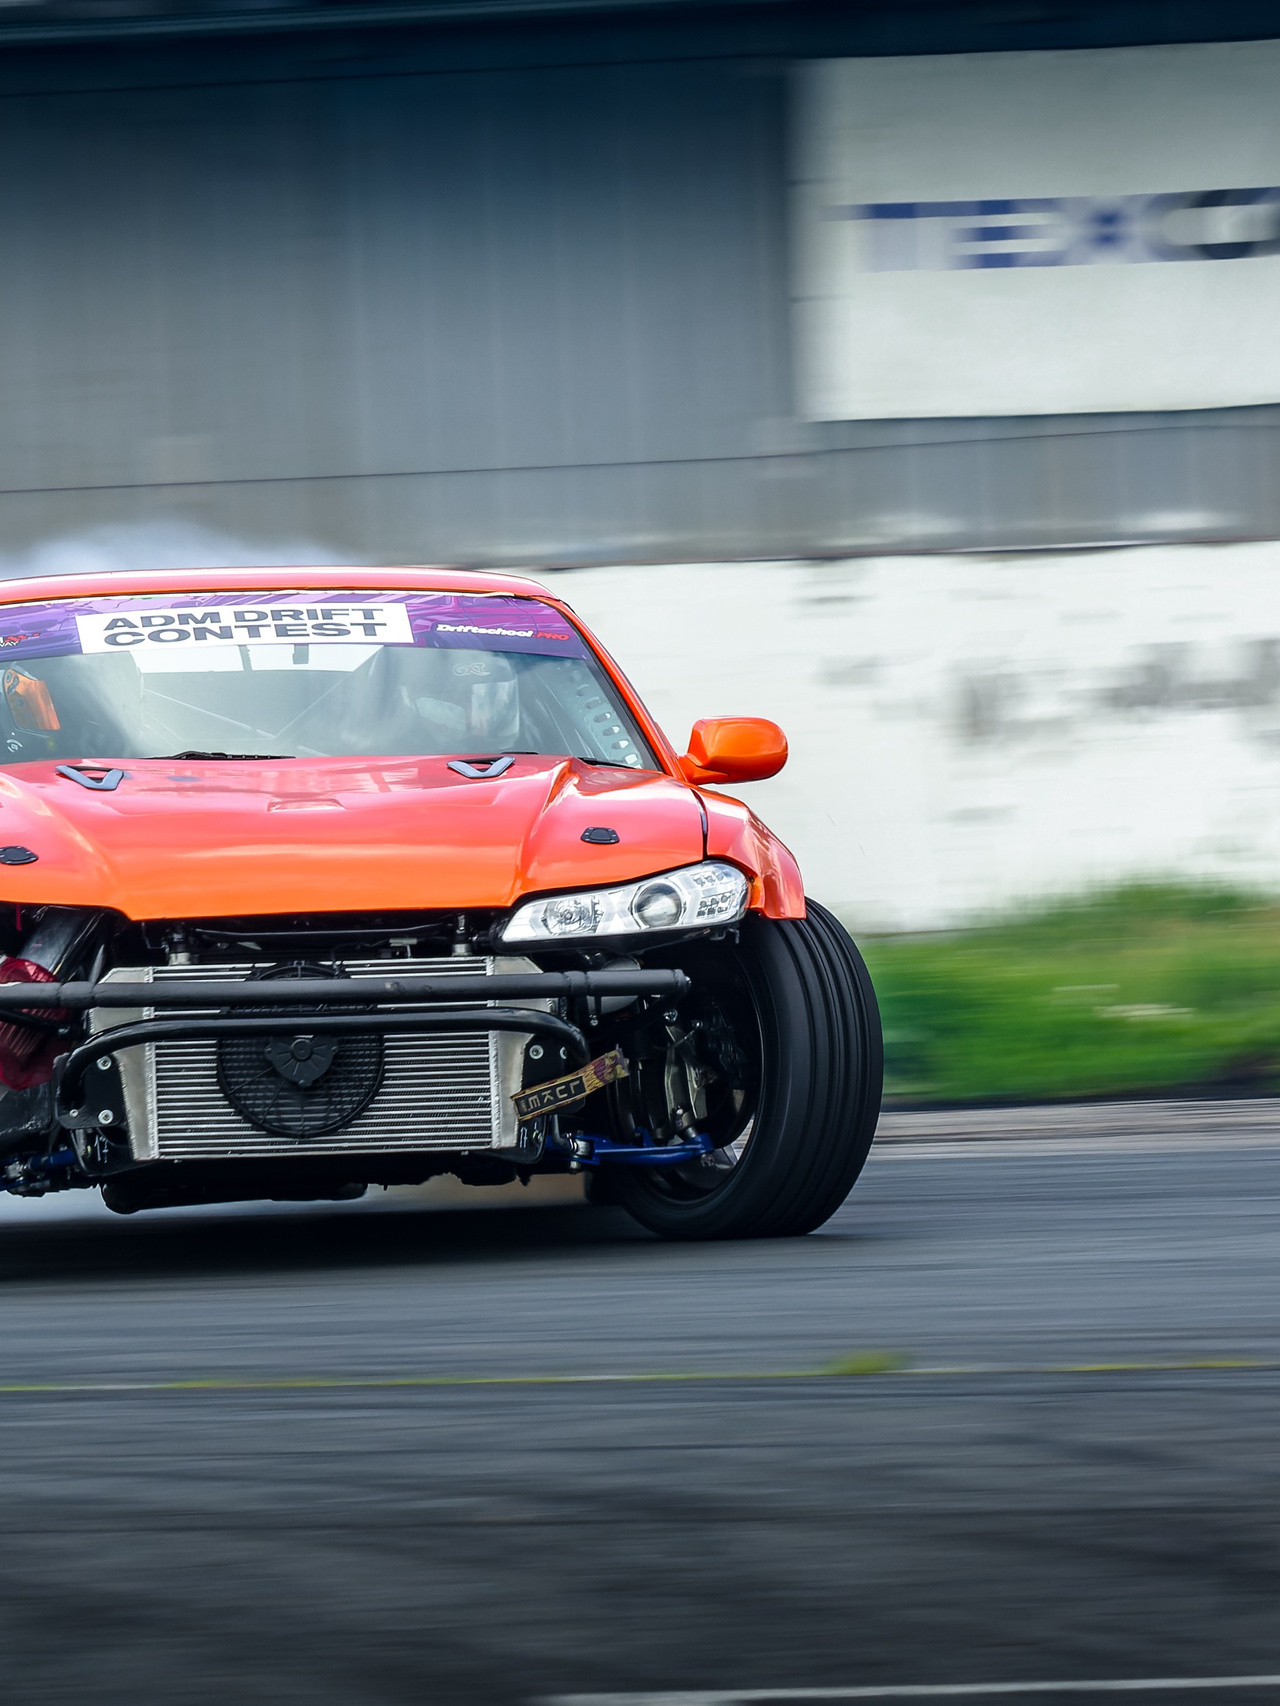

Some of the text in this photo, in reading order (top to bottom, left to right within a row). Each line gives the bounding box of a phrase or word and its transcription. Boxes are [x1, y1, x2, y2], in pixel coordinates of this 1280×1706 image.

[103, 608, 383, 631] ADM DRIFT
[104, 622, 387, 646] CONTEST
